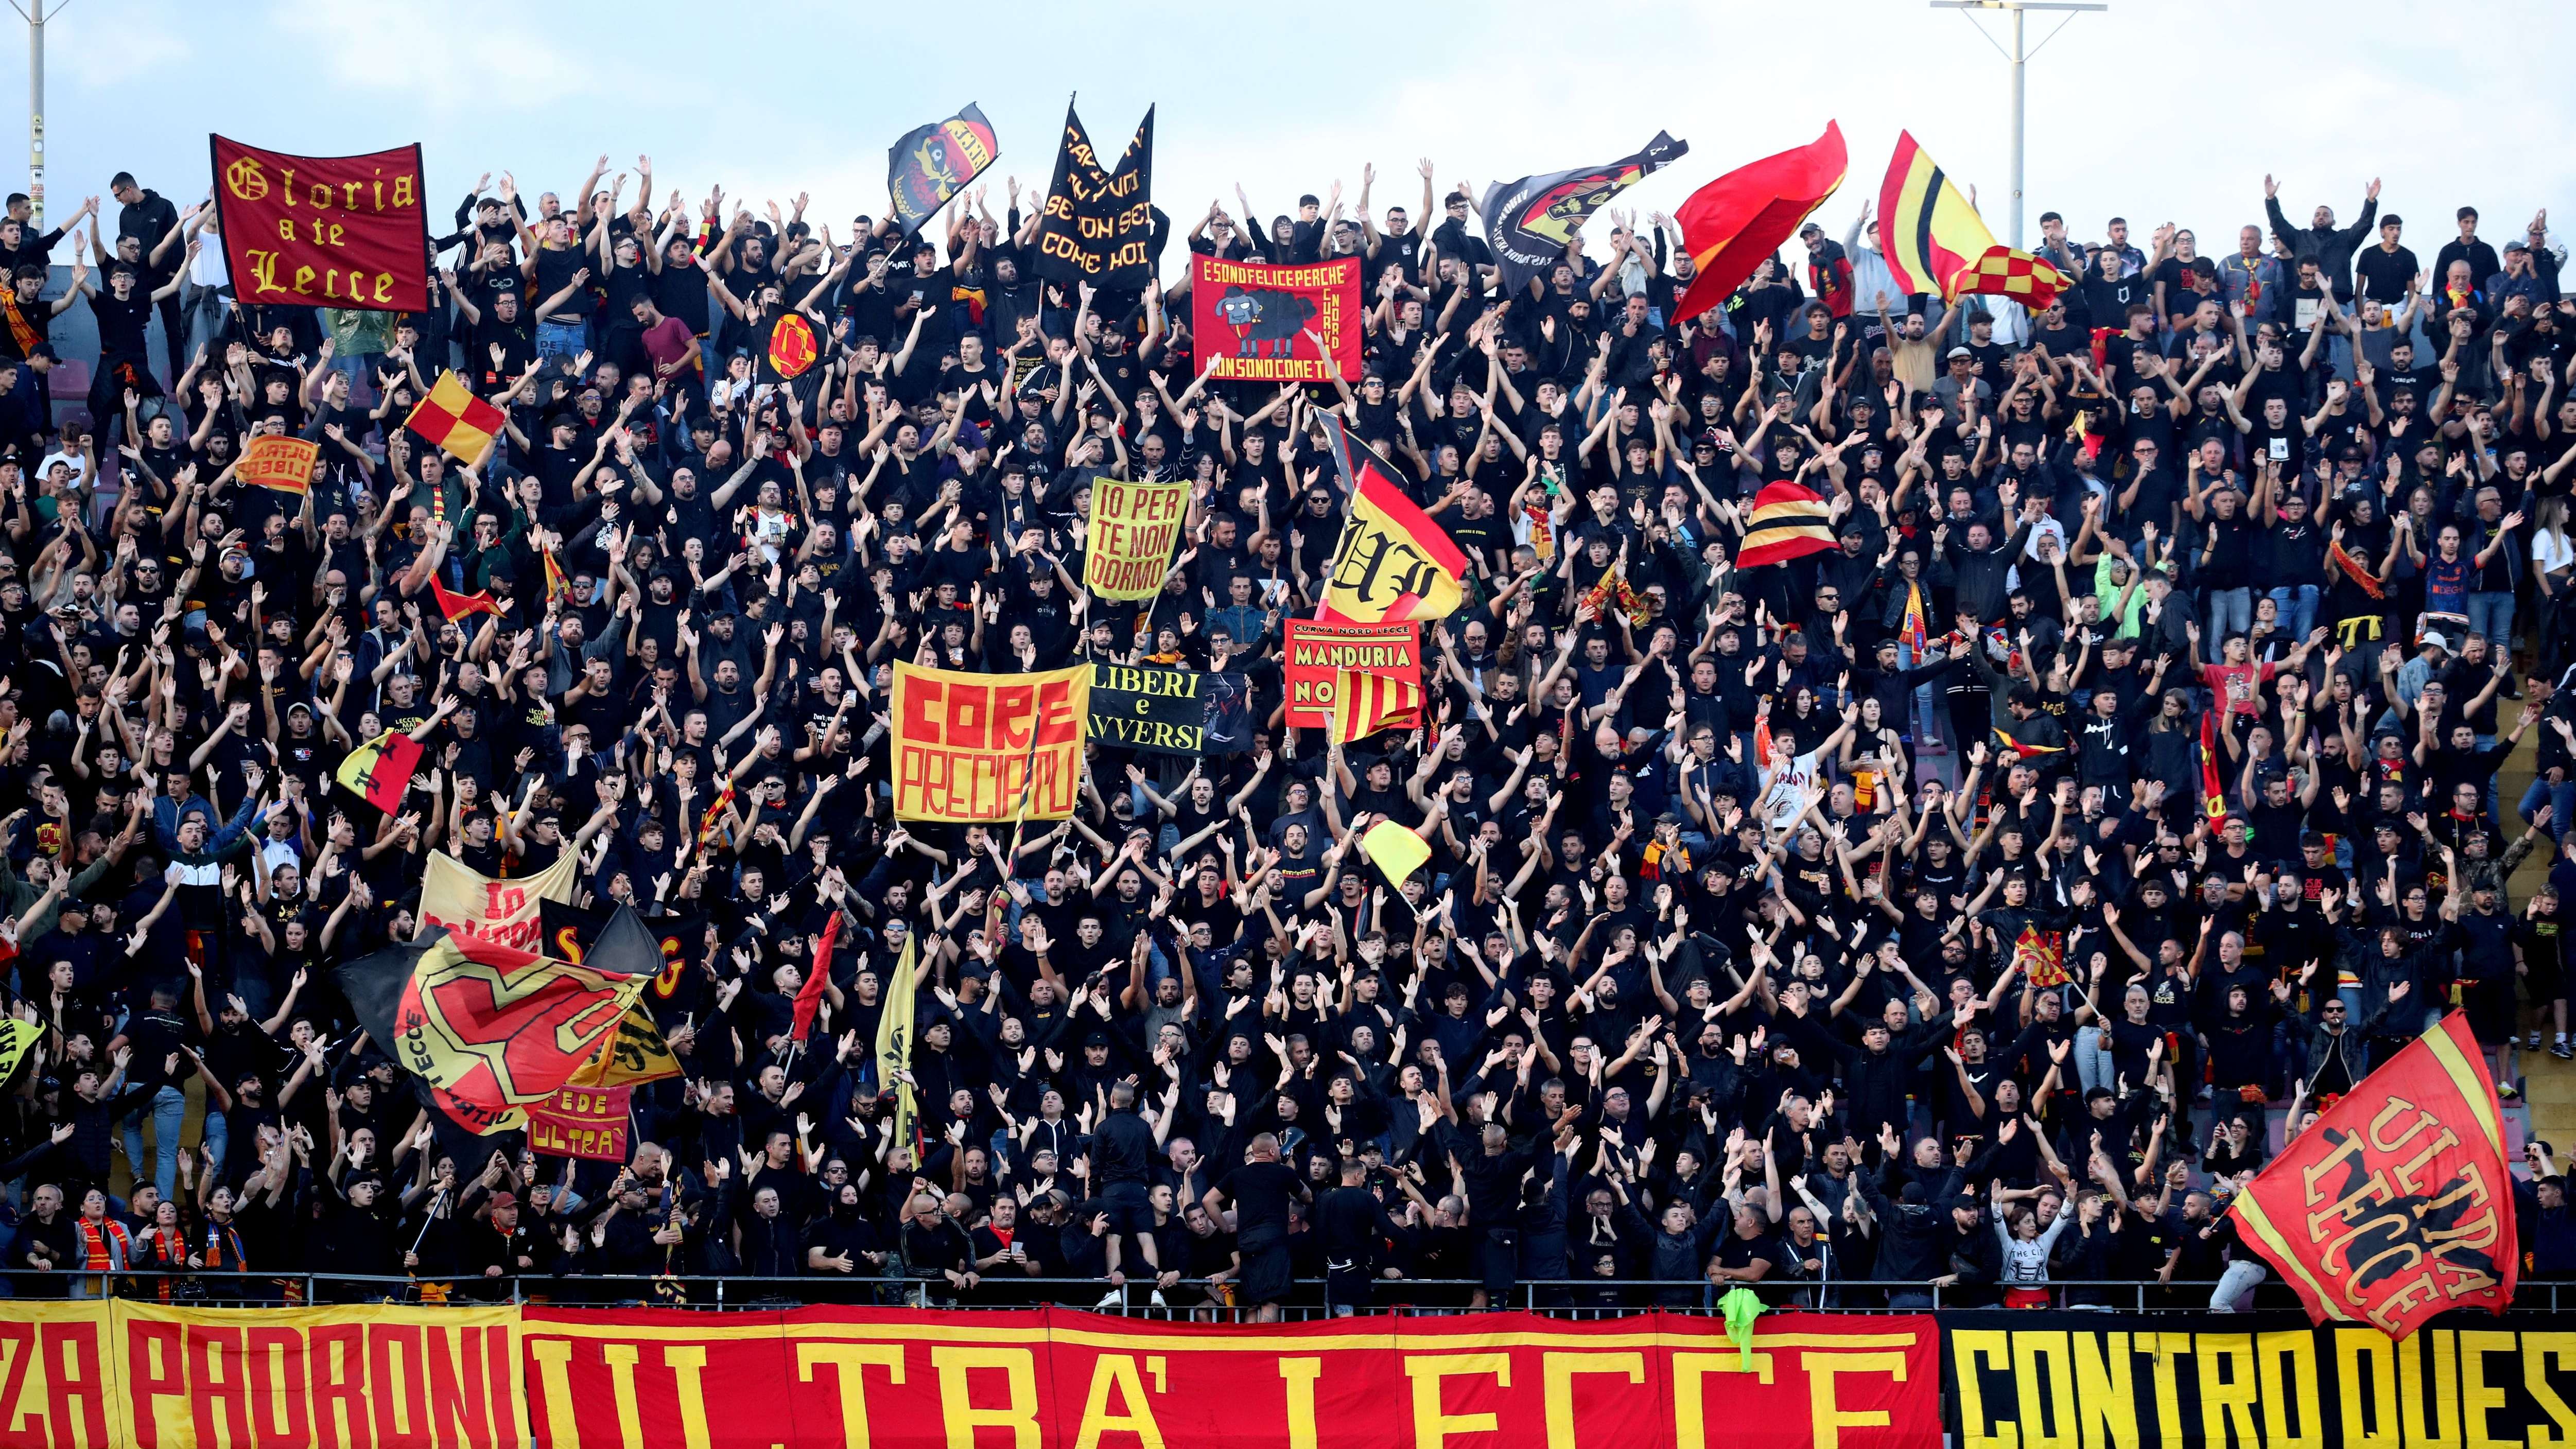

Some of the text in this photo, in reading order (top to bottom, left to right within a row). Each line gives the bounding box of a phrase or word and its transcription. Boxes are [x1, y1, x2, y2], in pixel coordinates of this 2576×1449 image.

[227, 156, 414, 212] Gloria
[279, 217, 345, 247] a te
[1043, 195, 1151, 238] SE ON SEI
[1041, 231, 1101, 274] COME
[1100, 484, 1180, 520] IO PER
[1098, 520, 1173, 557] TE NON
[1092, 553, 1164, 591] DORMO
[1294, 625, 1409, 635] CURVA NORD LECCE
[1294, 643, 1411, 668] MANDURIA
[1089, 664, 1200, 699] LIBERI
[526, 716, 545, 726] DOMA
[903, 674, 1076, 749] CORE
[1136, 699, 1149, 715] e
[1086, 713, 1203, 751] AVVERSI
[2302, 1128, 2441, 1334] LECCE
[127, 1318, 520, 1449] PADRONI
[1951, 1329, 2321, 1449] CONTRO
